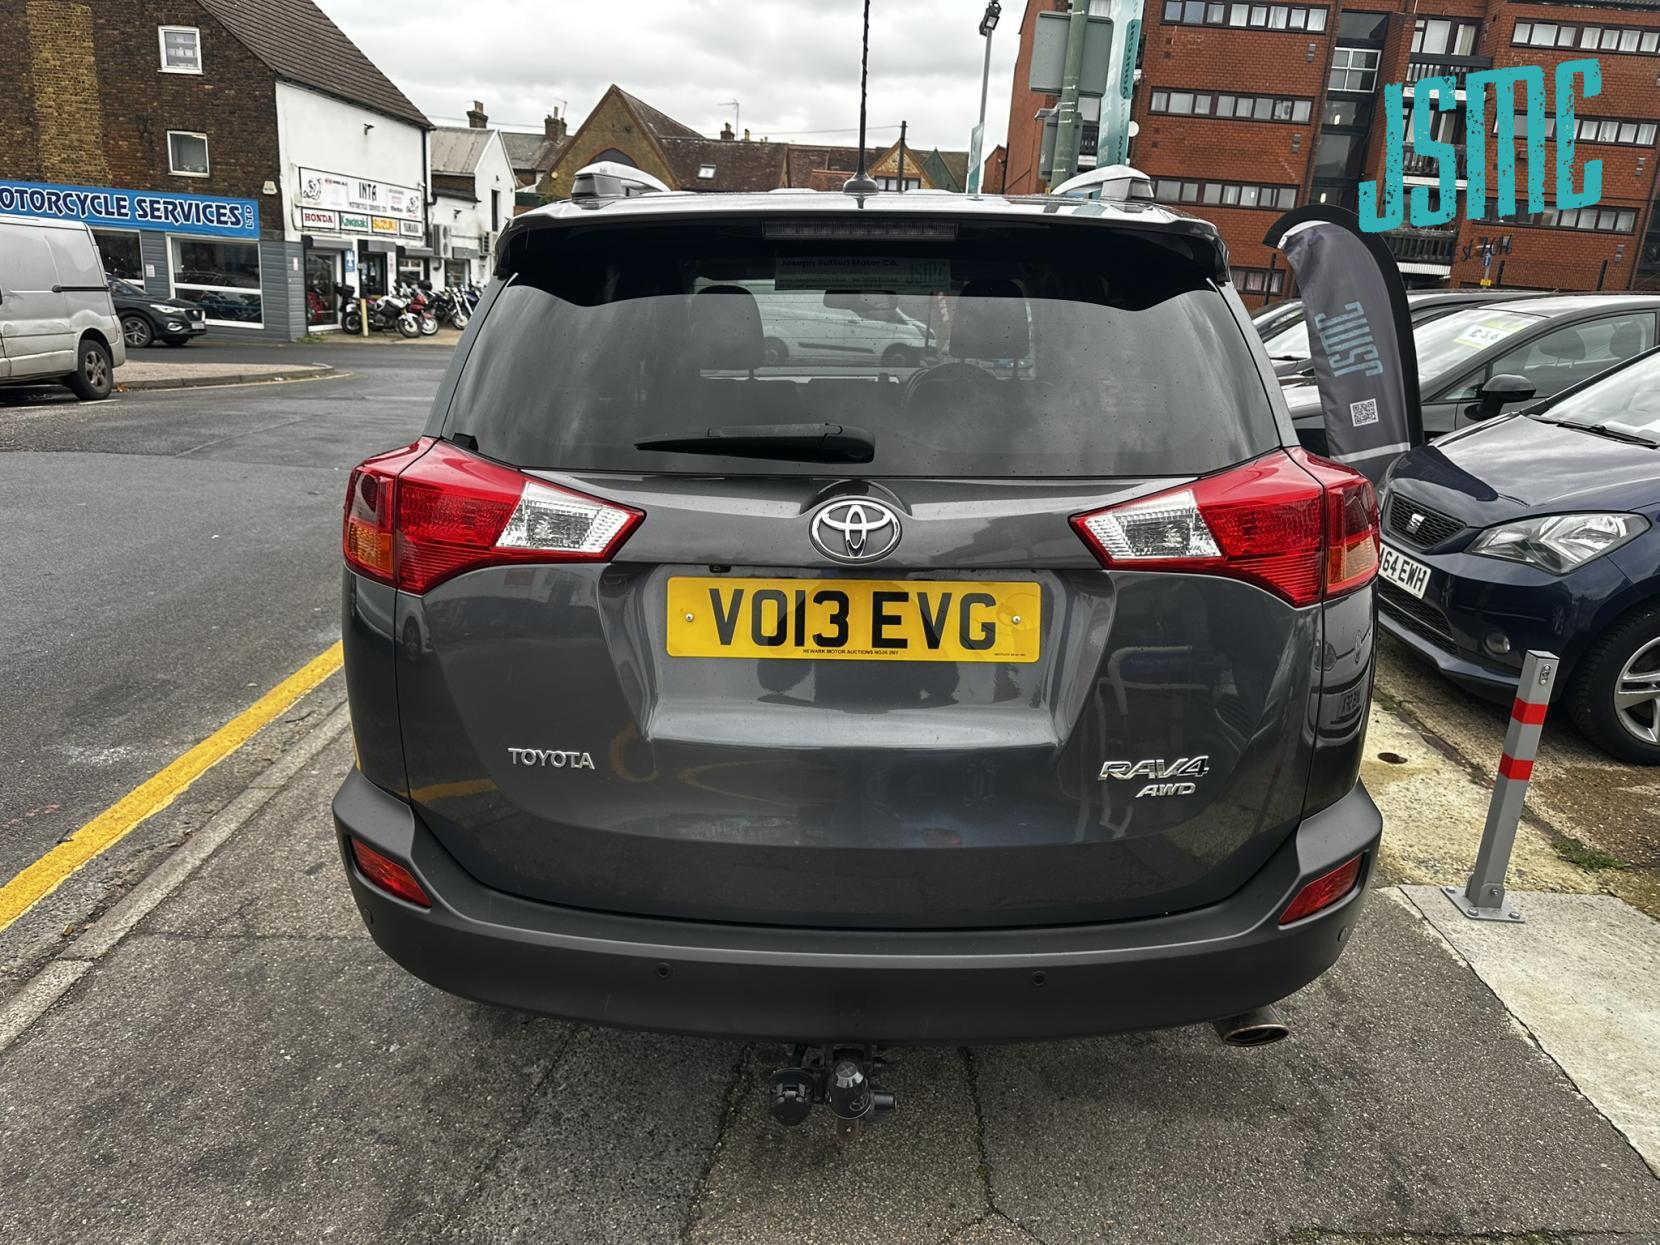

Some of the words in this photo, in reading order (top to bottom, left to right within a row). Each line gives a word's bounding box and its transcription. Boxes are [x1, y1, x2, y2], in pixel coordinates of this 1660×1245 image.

[358, 181, 377, 201] INTA
[136, 196, 243, 228] SERVICES
[244, 205, 254, 229] LTD
[304, 213, 333, 224] HONDA
[341, 215, 369, 228] Kawasaki
[373, 219, 397, 231] SUZUKI
[852, 258, 880, 267] Motor
[1314, 301, 1383, 377] JSMC
[1398, 559, 1427, 592] EWH
[708, 589, 850, 648] VO13
[872, 591, 996, 650] EVG
[507, 748, 595, 769] TOYOTA
[1098, 755, 1209, 780] RAV4
[1135, 782, 1196, 798] AWD
